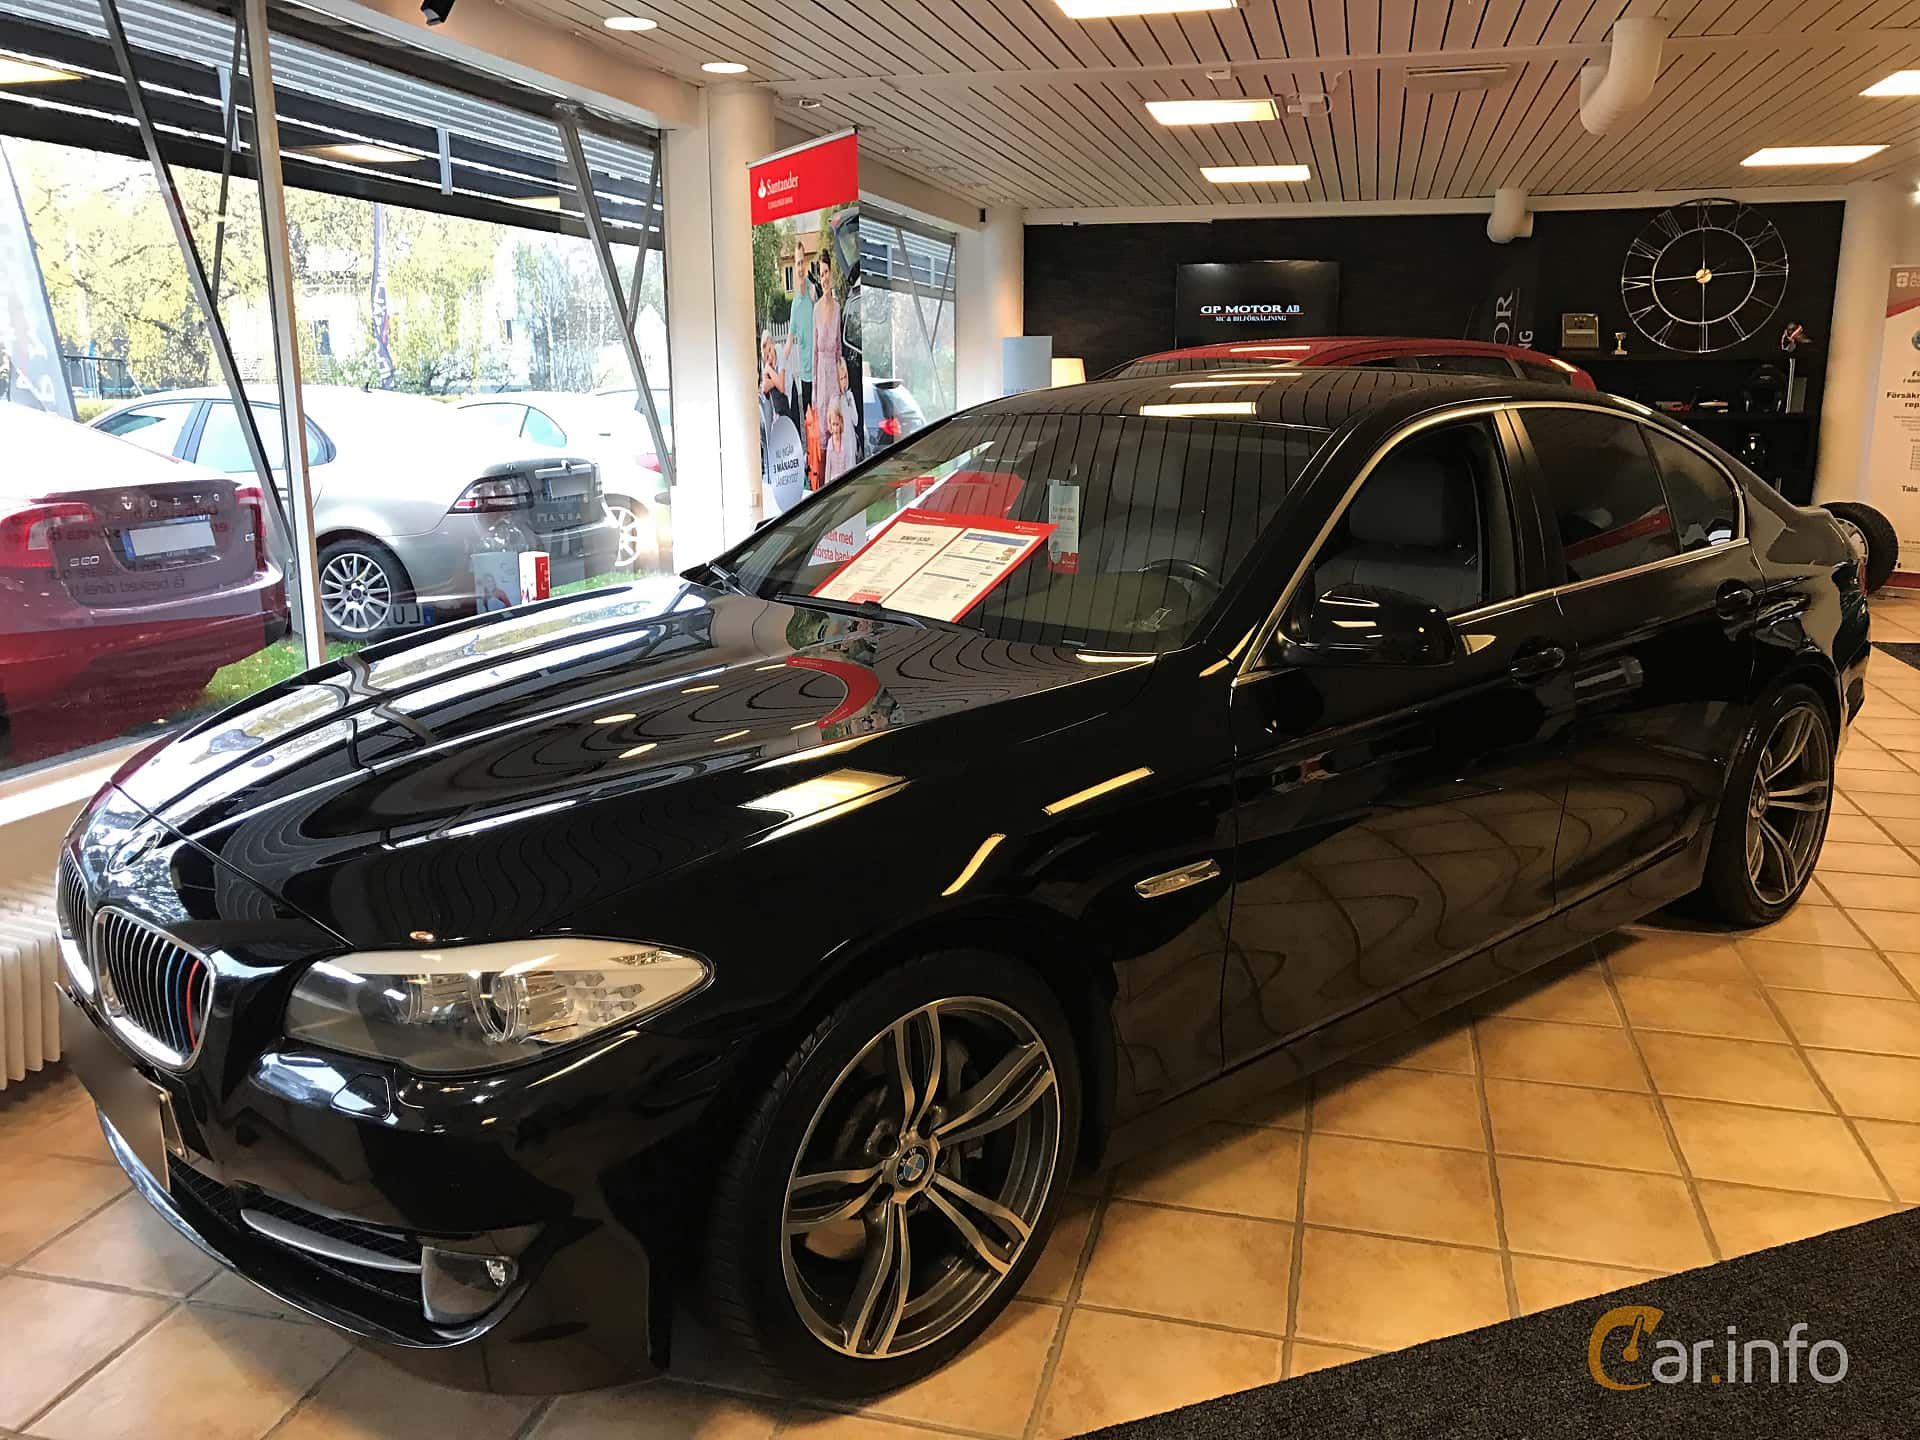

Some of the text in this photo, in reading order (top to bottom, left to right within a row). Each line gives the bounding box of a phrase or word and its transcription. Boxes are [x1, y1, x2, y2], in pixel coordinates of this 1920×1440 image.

[767, 171, 799, 196] Santander
[1200, 304, 1300, 314] GP MOTOR AB
[777, 457, 799, 472] MÅNADER
[121, 493, 220, 510] VOLVO
[838, 531, 854, 545] med
[70, 555, 100, 568] S60
